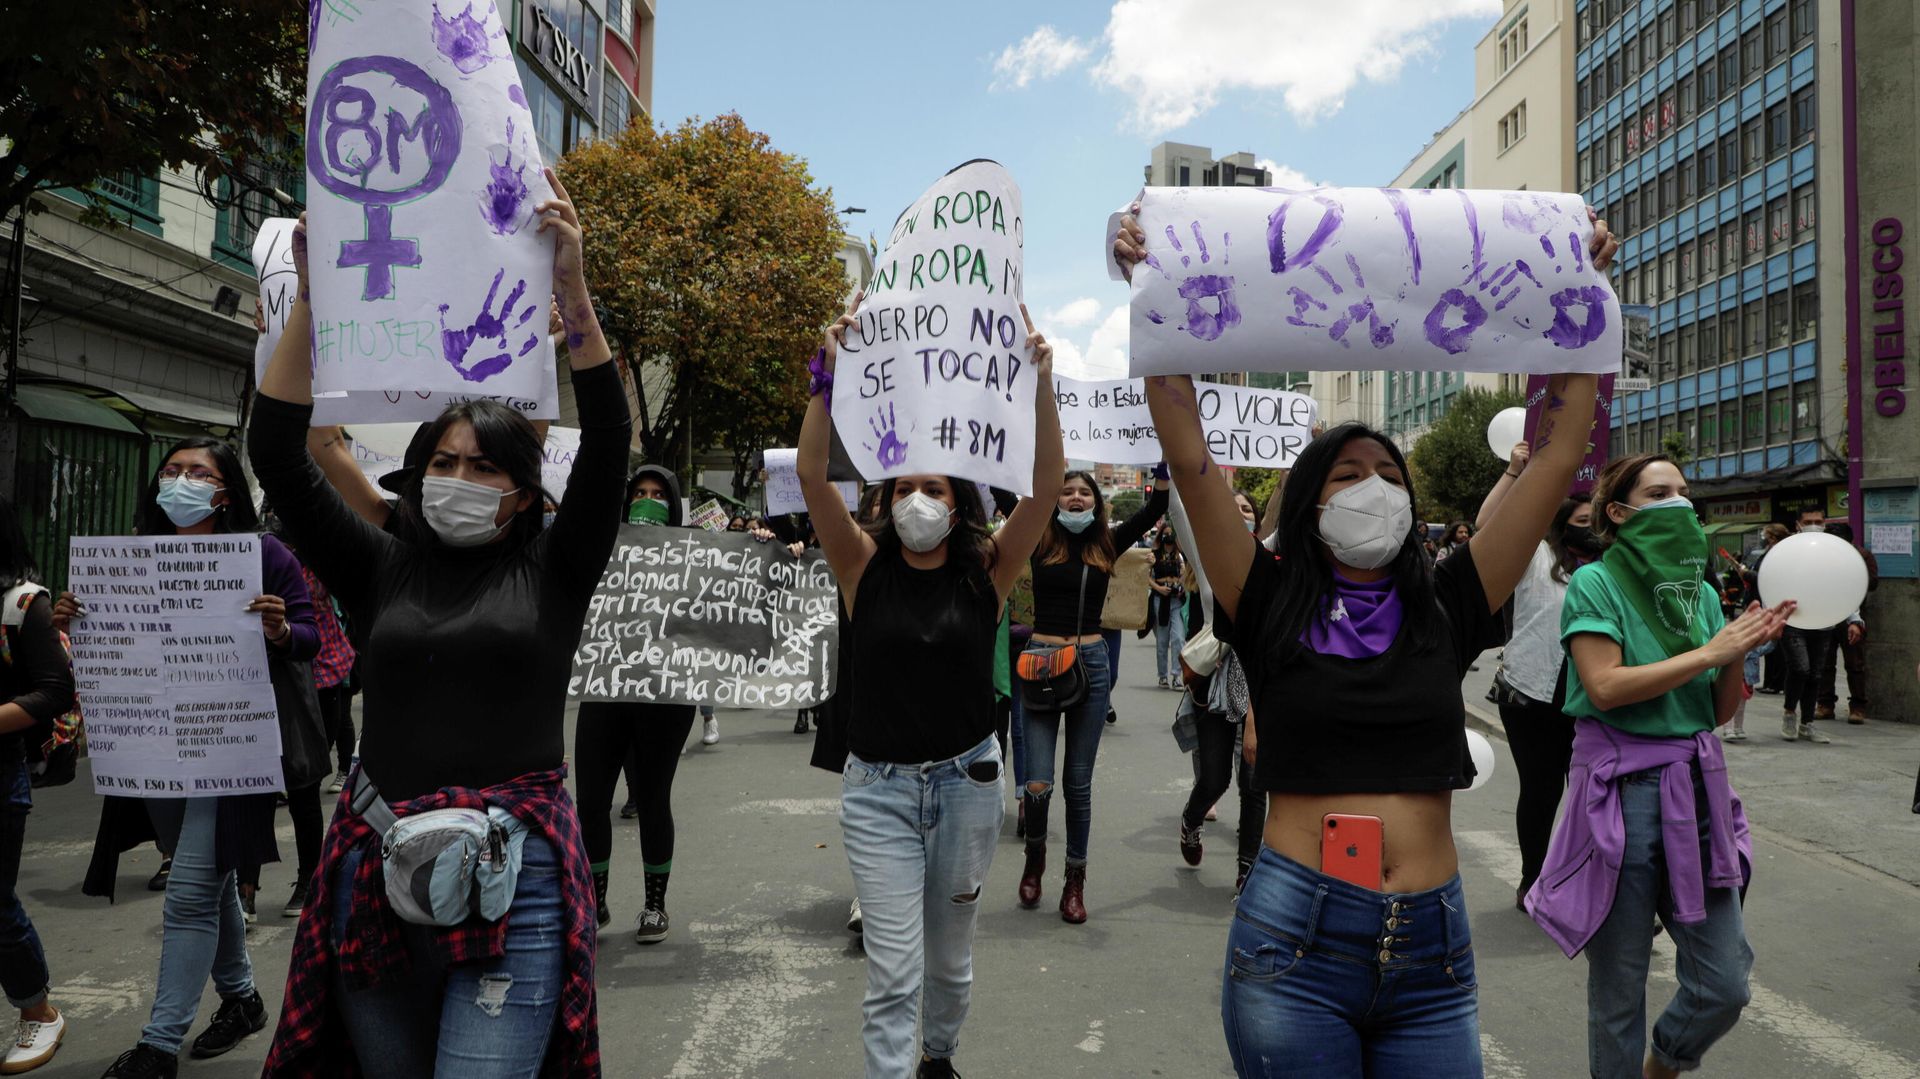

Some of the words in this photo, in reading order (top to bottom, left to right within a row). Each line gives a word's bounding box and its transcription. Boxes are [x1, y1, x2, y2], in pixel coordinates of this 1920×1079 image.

[554, 26, 593, 97] SKY
[325, 85, 439, 177] 8M
[934, 190, 1006, 236] ROPA
[910, 244, 995, 295] ROPA,
[1872, 217, 1906, 417] OBELISCO
[970, 307, 1016, 349] NO
[318, 317, 436, 364] #MUJER
[860, 357, 895, 399] SE
[915, 347, 1021, 402] TOCA!
[1088, 389, 1110, 408] de
[1070, 429, 1081, 441] a
[1089, 420, 1112, 441] las
[932, 416, 1006, 463] #8M
[71, 547, 98, 558] FELIZ
[101, 547, 117, 558] VA
[121, 548, 129, 558] A
[132, 548, 152, 558] SER
[155, 542, 188, 554] NUNCA
[239, 542, 253, 553] LA
[618, 532, 762, 576] resistencia
[71, 565, 84, 576] EL
[109, 566, 130, 577] QUE
[133, 567, 147, 577] NO
[209, 560, 219, 572] DE
[72, 584, 107, 595] FALTE
[110, 584, 156, 595] NINGUNA
[159, 580, 200, 592] NUESTRO
[204, 579, 246, 591] SILENCIO
[88, 603, 99, 613] SE
[105, 603, 119, 613] VA
[123, 603, 130, 613] A
[133, 604, 160, 613] CAER
[161, 598, 183, 609] OTRA
[186, 598, 204, 609] VEZ
[672, 596, 767, 626] contra
[765, 607, 795, 640] tu
[91, 621, 125, 632] VAMOS
[129, 622, 136, 632] A
[139, 623, 172, 632] TIRAR
[161, 636, 178, 646] NOS
[181, 635, 235, 646] QUISIERON
[671, 642, 814, 677] impunidad
[80, 695, 93, 704] NOS
[94, 695, 129, 704] QUITARON
[129, 695, 153, 704] TANTO
[174, 703, 190, 712] NOS
[227, 702, 233, 711] A
[235, 700, 250, 710] SER
[101, 707, 171, 720] TERMINARON
[206, 713, 228, 723] PERO
[229, 710, 276, 723] DECIDIMOS
[175, 728, 190, 736] SER
[177, 737, 188, 746] NO
[190, 736, 215, 746] TIENES
[245, 734, 258, 743] NO
[178, 749, 207, 758] OPINES
[96, 775, 114, 787] SER
[144, 779, 166, 791] ESO
[169, 780, 184, 792] ES
[195, 775, 275, 790] REVOLUCION
